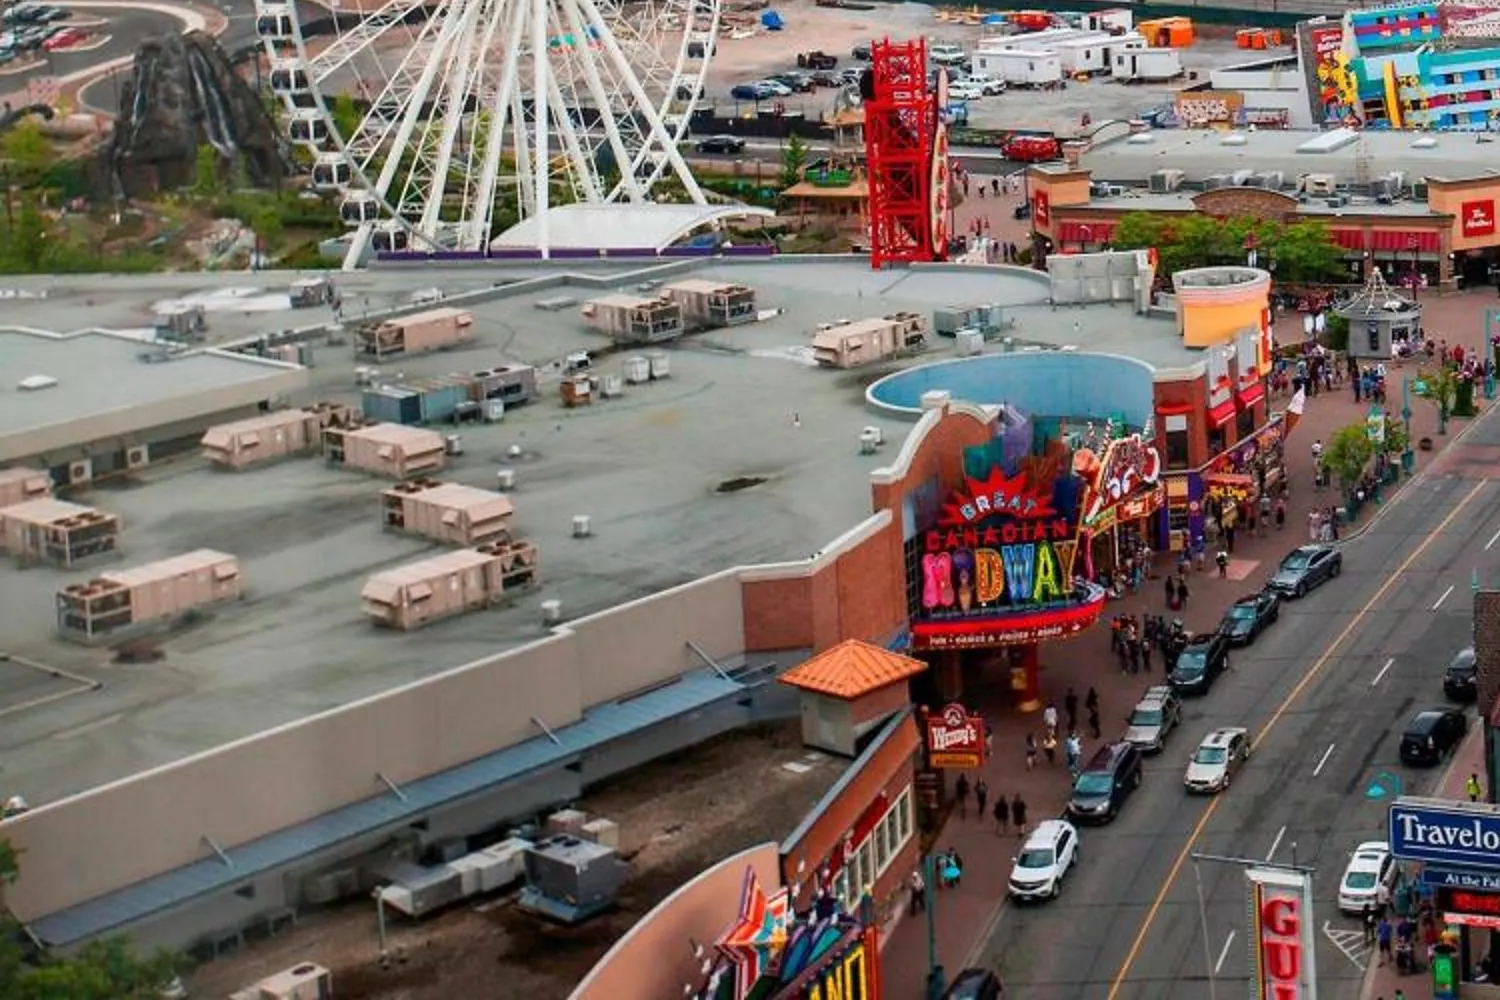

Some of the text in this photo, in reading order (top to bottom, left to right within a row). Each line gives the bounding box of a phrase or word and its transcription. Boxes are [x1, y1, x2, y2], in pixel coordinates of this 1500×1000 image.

[959, 491, 1037, 521] GREAT
[926, 519, 1068, 550] CANADIAN
[1445, 873, 1460, 885] At
